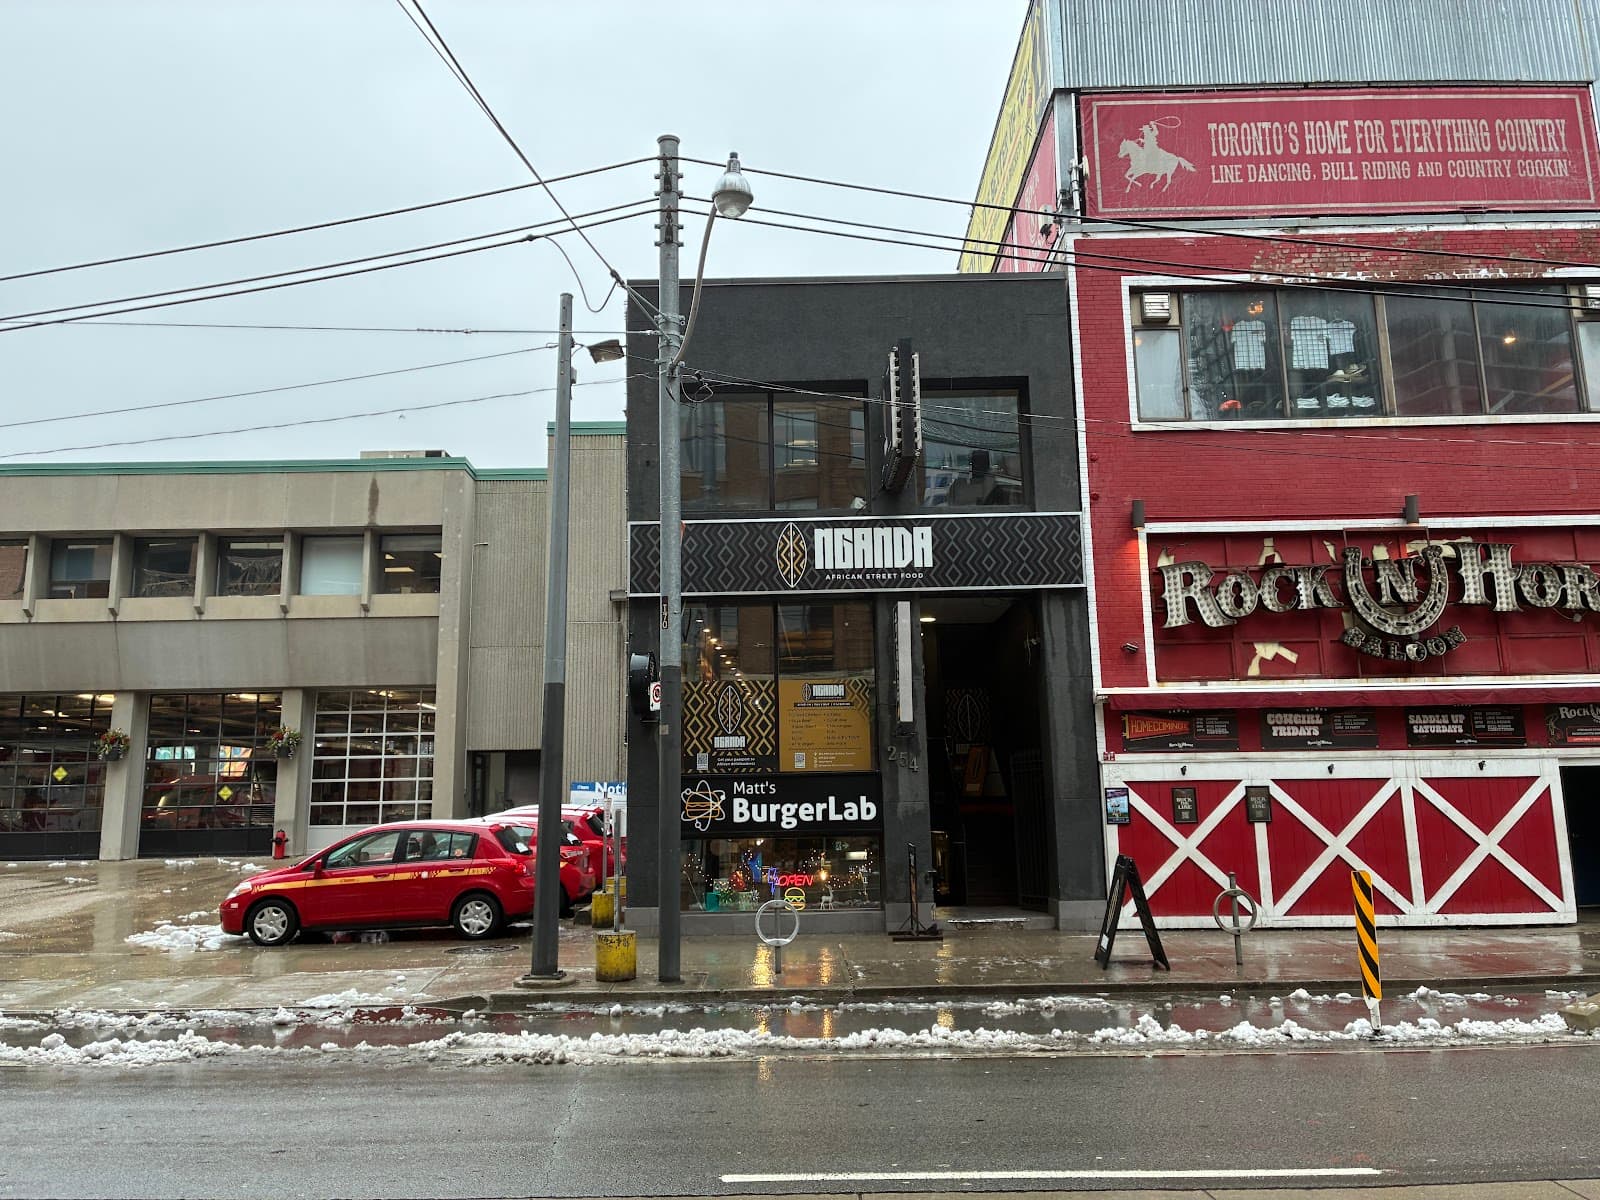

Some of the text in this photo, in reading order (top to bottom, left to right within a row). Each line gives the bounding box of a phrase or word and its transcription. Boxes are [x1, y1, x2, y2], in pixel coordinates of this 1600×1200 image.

[1208, 118, 1568, 157] TORONTO'S HOME FOR EVERYTHING COUNTRY
[1211, 159, 1572, 183] LINE DANCING, BULL RIDING AND COUNTRY COOKIN'
[814, 526, 934, 570] NGANDA
[825, 573, 863, 581] AFRICAN
[1266, 713, 1323, 725] COWGIRL
[1408, 714, 1449, 724] SADDLE
[1451, 714, 1465, 724] UP
[1271, 725, 1320, 736] FRIDAYS
[1412, 725, 1464, 734] SATURDAYS
[887, 745, 920, 773] 254
[595, 781, 627, 795] Noti
[733, 781, 776, 795] Matt's
[733, 795, 877, 830] BurgerLab
[778, 873, 814, 887] OPEN
